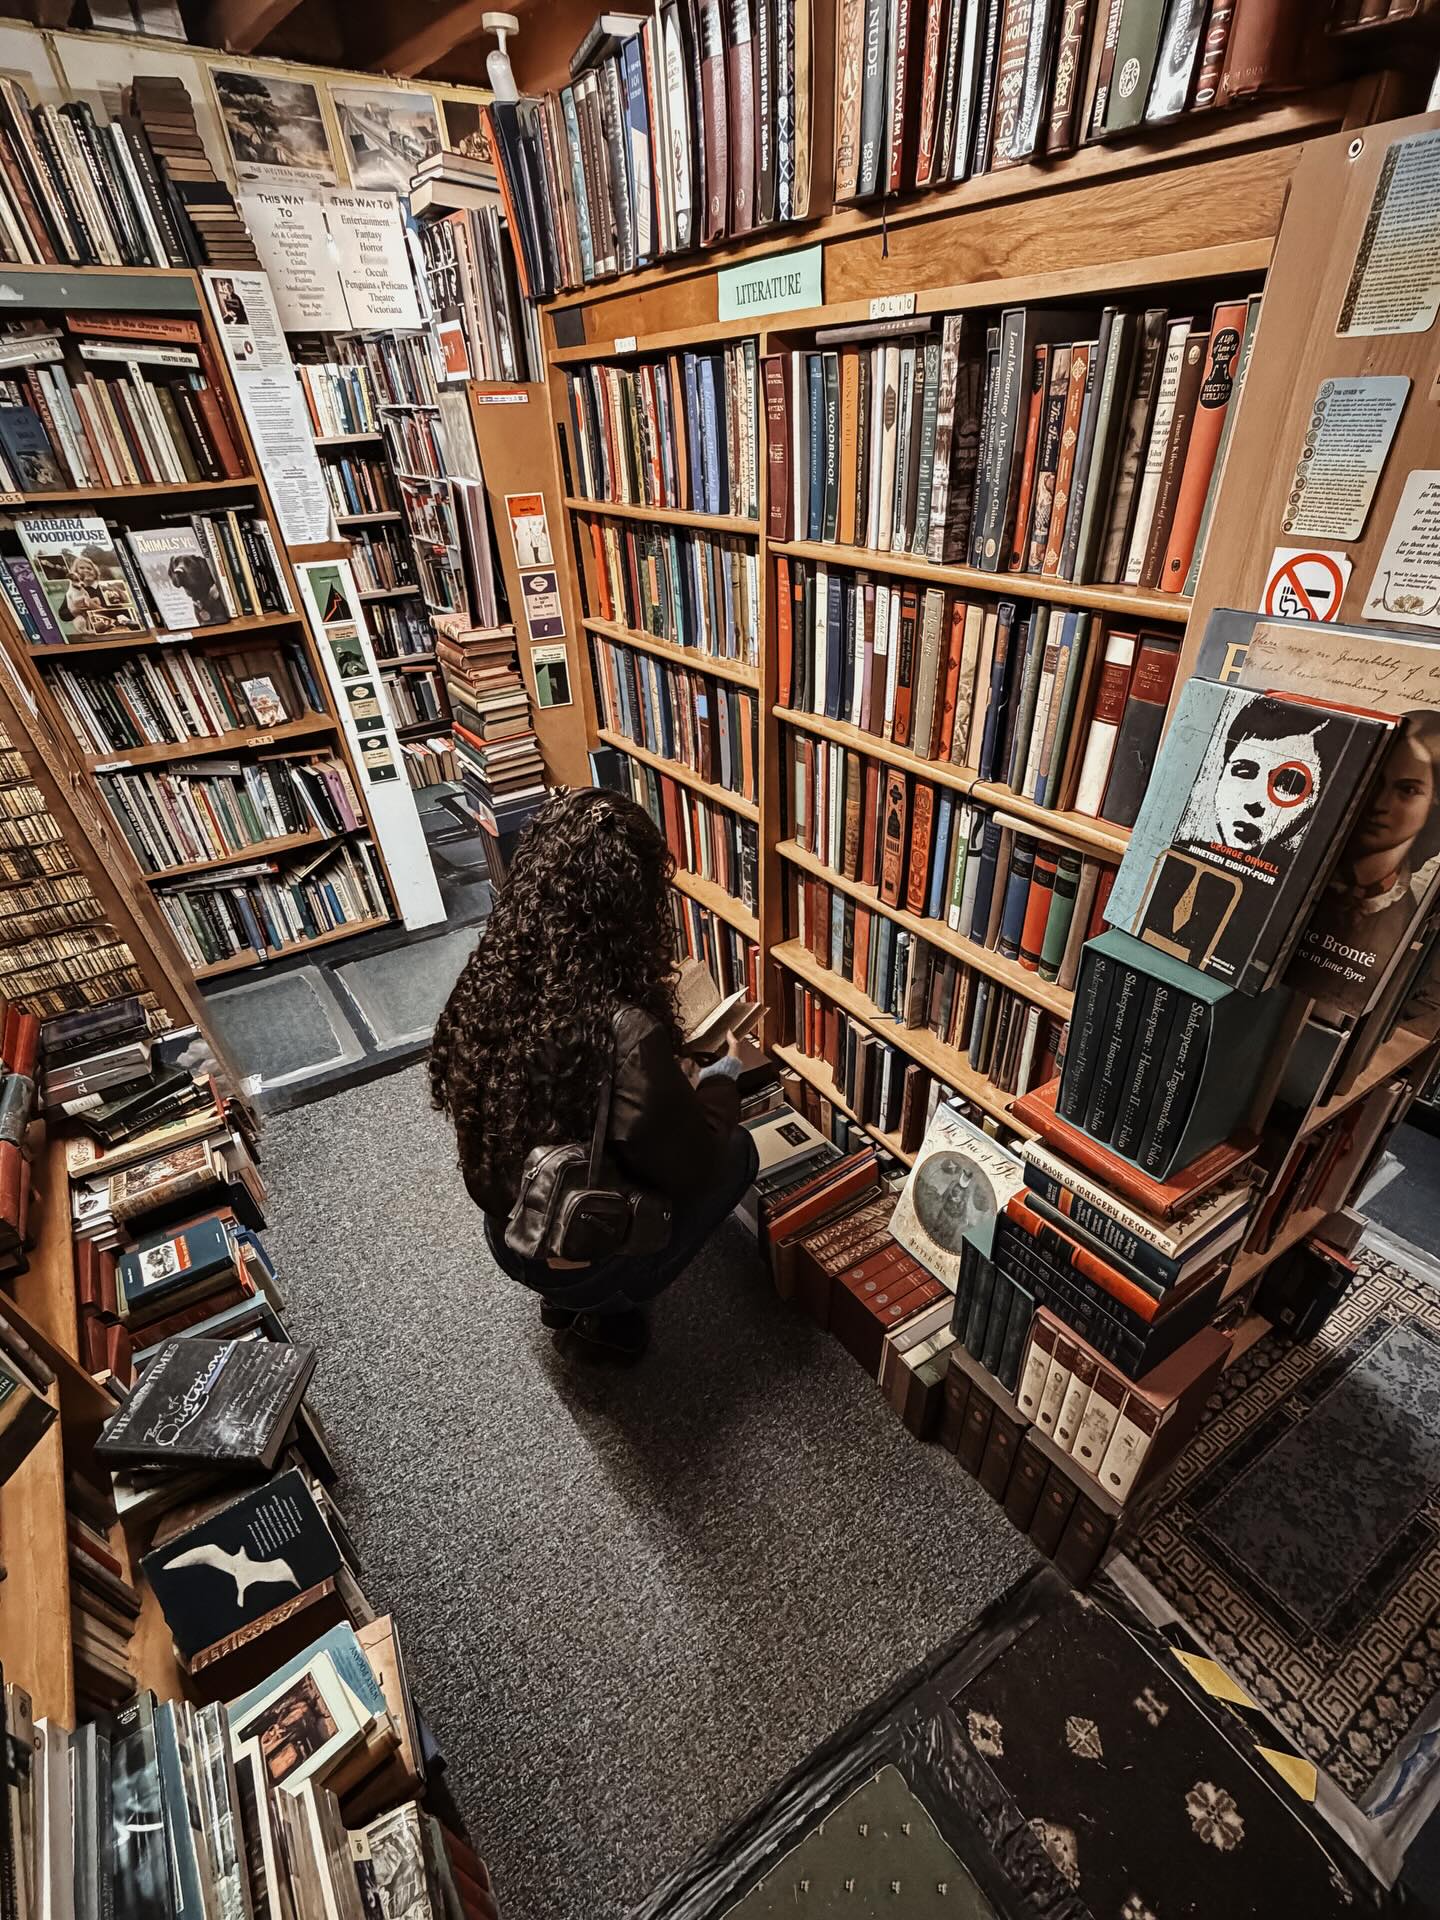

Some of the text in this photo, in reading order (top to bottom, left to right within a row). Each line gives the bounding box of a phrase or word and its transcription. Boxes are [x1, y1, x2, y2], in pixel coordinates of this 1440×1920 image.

[896, 0, 908, 52] OMAR
[865, 5, 880, 79] NUDE
[758, 5, 769, 115] UNDERTONES OF WAR
[1196, 8, 1232, 105] FOLIO
[975, 26, 996, 156] WOOD FOLIO SOCIETY
[1093, 85, 1107, 127] SOCIETY
[863, 140, 875, 182] FOLIO
[130, 133, 180, 251] THE BEST OF JAMES HERRIOT
[257, 193, 304, 205] THIS WAY
[331, 196, 359, 207] THIS
[359, 197, 376, 207] WAY
[278, 207, 293, 218] TO
[340, 214, 390, 226] Entertainment
[355, 229, 382, 241] Fantasy
[359, 243, 383, 251] Horror
[345, 280, 408, 290] Penguins Pelicans
[365, 268, 388, 277] Occult
[369, 293, 395, 302] Theatre
[736, 271, 802, 306] LITERATURE
[366, 304, 403, 314] Victoriana
[871, 298, 912, 314] FOLIO
[1168, 353, 1179, 362] No
[1204, 384, 1231, 392] HECTOR
[809, 387, 817, 431] THOMAS
[825, 399, 837, 487] WOODBROOK
[987, 330, 1020, 530] Lord Macartney An Embassy to China
[1419, 491, 1429, 500] for
[23, 519, 85, 531] BARBARA
[1413, 508, 1425, 516] for
[26, 530, 106, 543] WOODHOUSE
[1411, 524, 1428, 532] those
[1395, 547, 1406, 555] but
[1406, 549, 1416, 557] for
[1400, 541, 1410, 550] for
[247, 737, 273, 747] CATS
[1189, 845, 1276, 885] NINETEEN EIGHTY-FOUR
[1210, 840, 1280, 875] GEORGE ORWELL
[1321, 933, 1377, 968] Brontë
[1320, 958, 1343, 973] Jane
[1343, 966, 1366, 983] Eyre
[1102, 1034, 1123, 1078] Histories
[1130, 1050, 1153, 1096] Histories
[1152, 1065, 1186, 1133] Tragicomedies
[1089, 1106, 1106, 1132] Folio
[1116, 1123, 1134, 1150] Folio
[1144, 1140, 1163, 1167] Folio
[1025, 1150, 1041, 1165] THE
[1041, 1160, 1063, 1182] BOOK
[1064, 1176, 1076, 1188] OF
[1076, 1182, 1121, 1220] MARGERY
[106, 1343, 180, 1442] THE TIMES
[155, 1344, 228, 1447] Quotations
